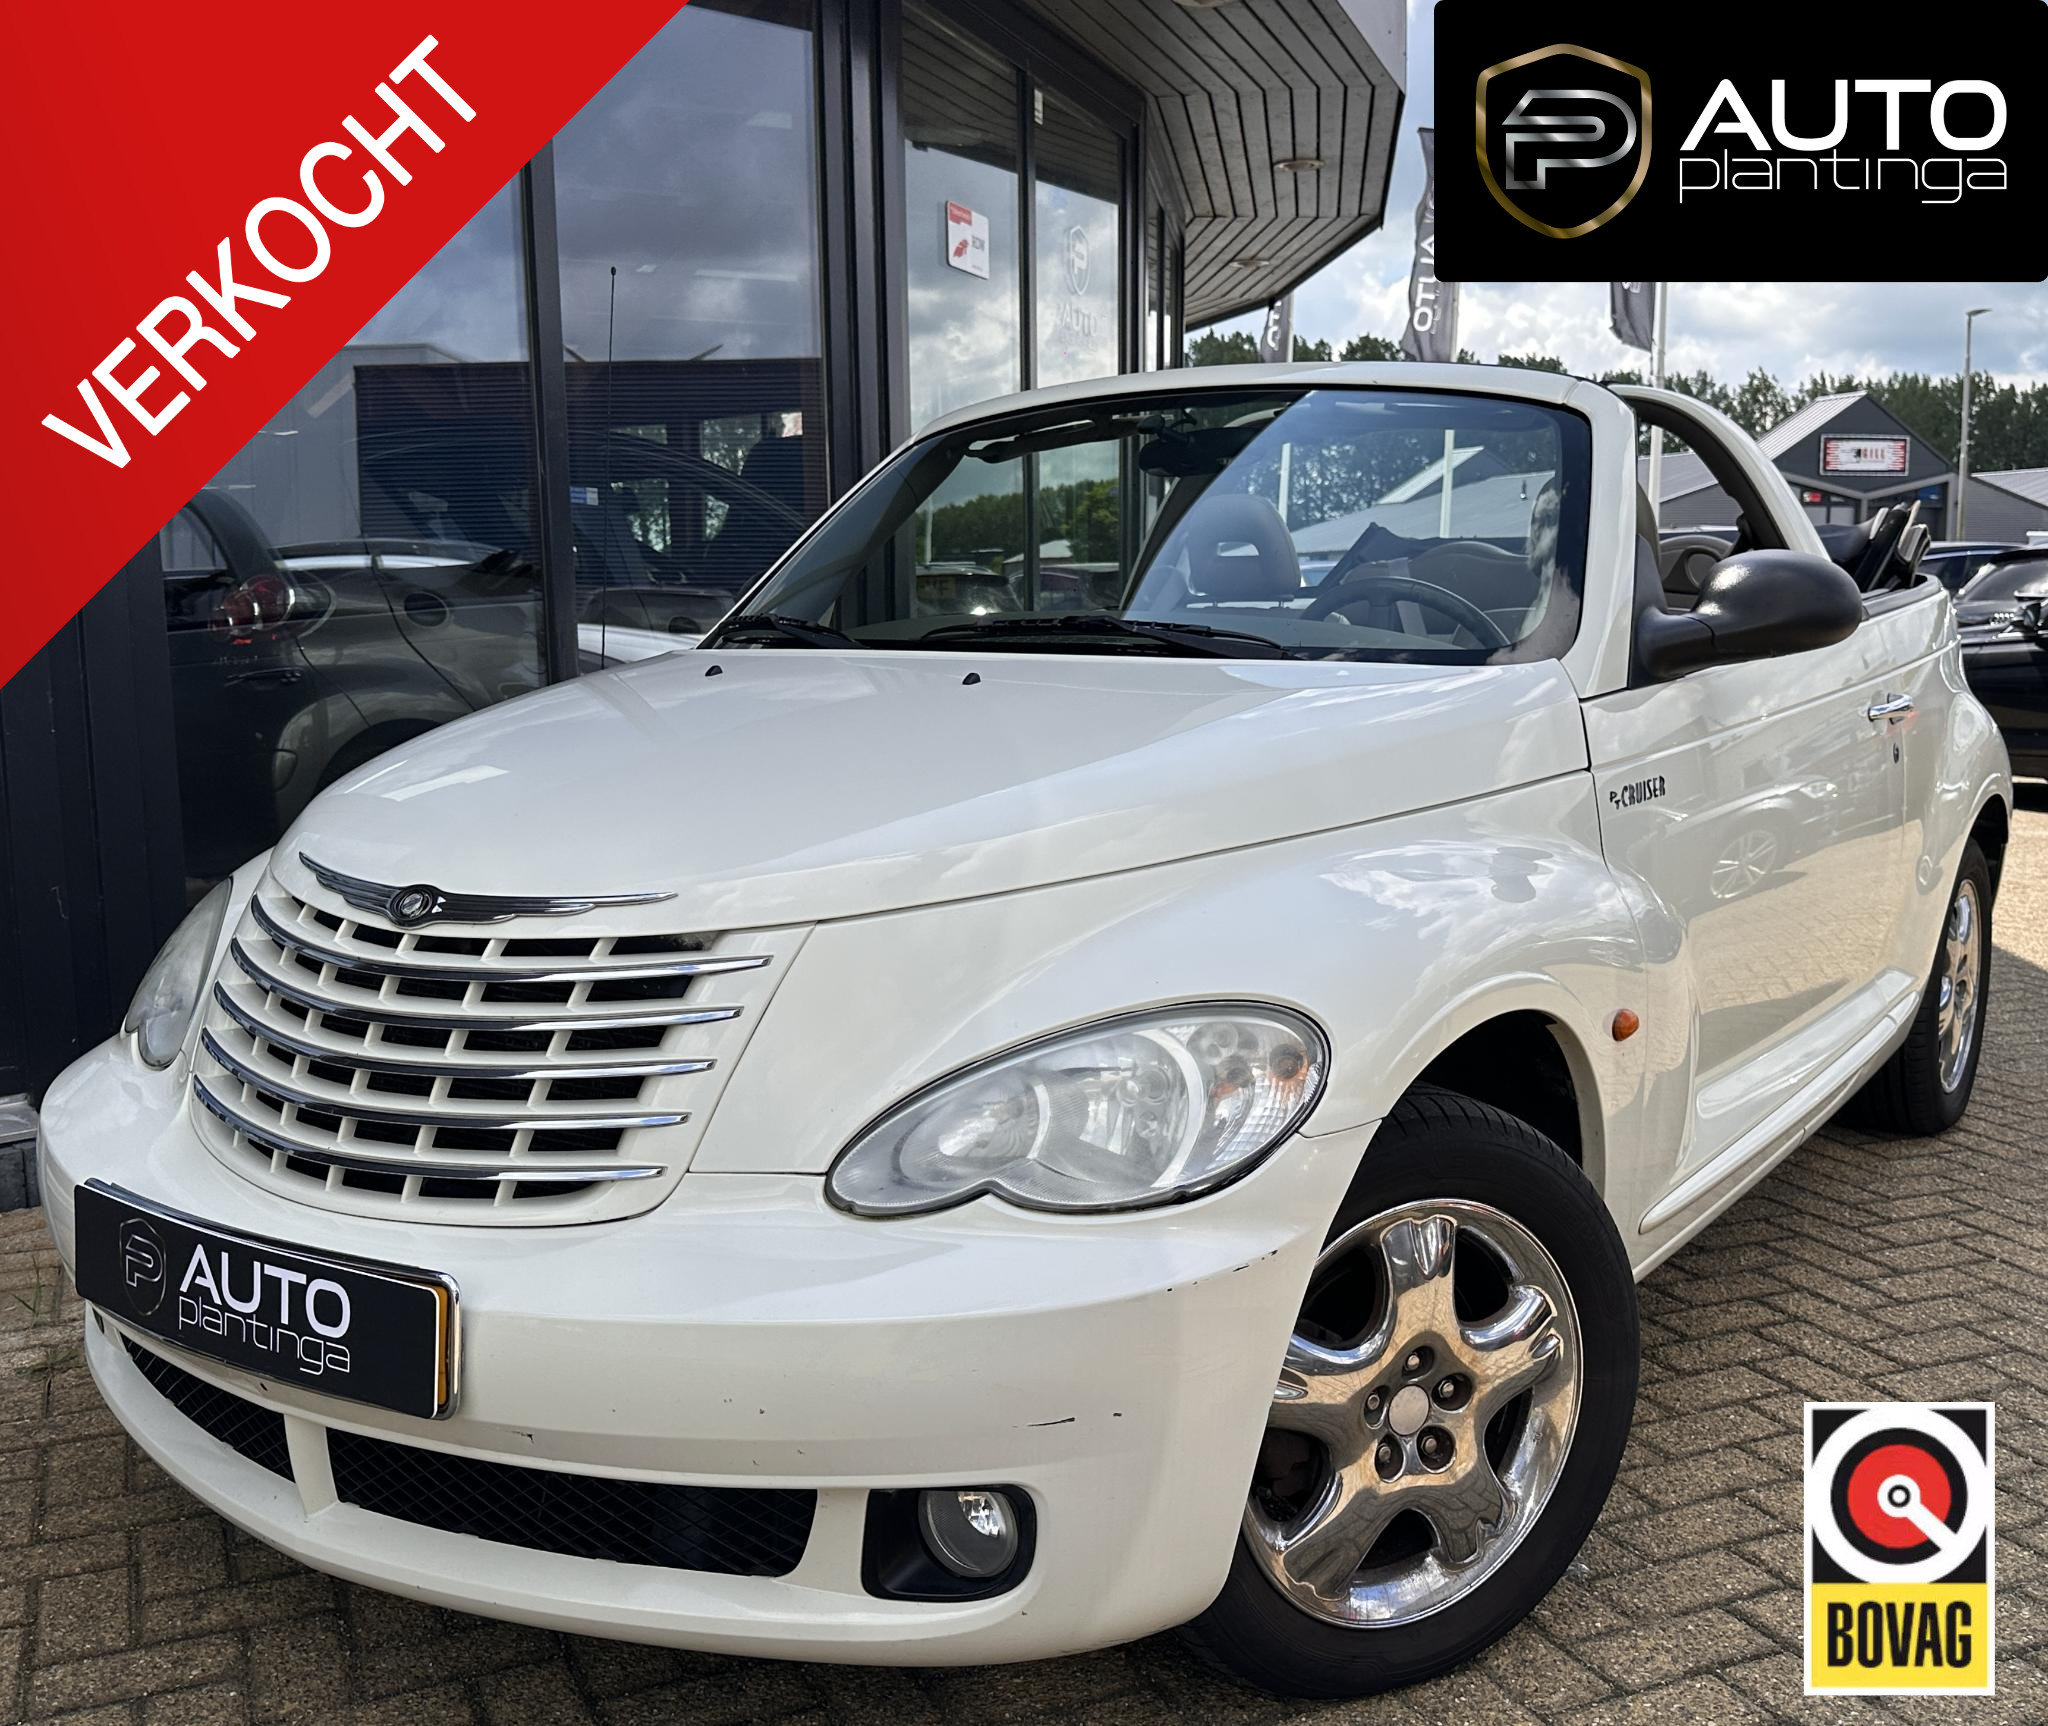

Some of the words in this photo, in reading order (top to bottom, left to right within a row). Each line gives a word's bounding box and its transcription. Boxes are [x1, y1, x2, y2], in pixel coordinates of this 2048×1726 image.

[1621, 775, 1666, 808] CRUISER
[178, 1243, 351, 1338] AUTO
[178, 1295, 351, 1376] plantinga
